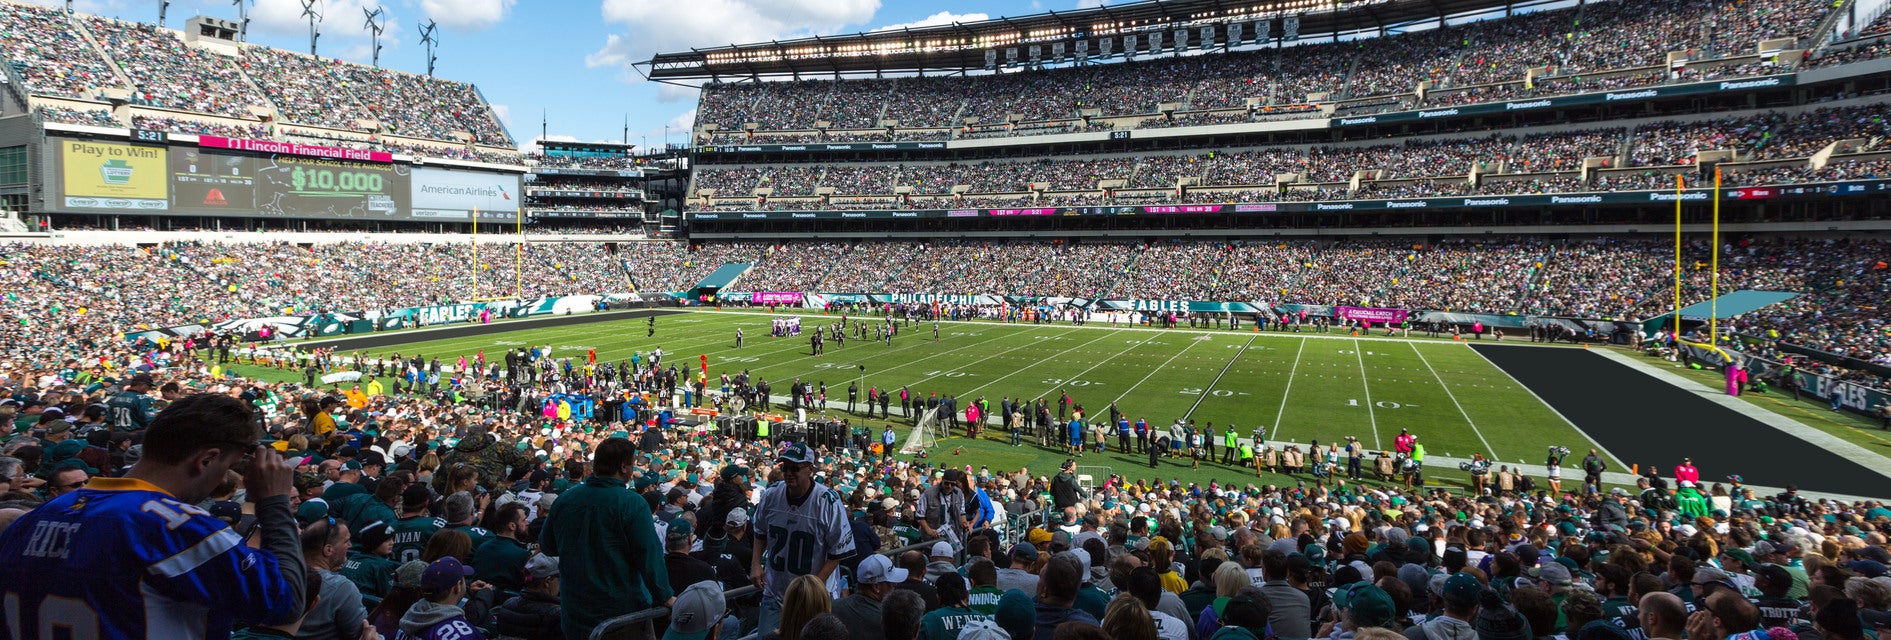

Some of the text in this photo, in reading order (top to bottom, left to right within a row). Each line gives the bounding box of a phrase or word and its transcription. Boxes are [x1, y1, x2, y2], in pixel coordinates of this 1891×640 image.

[1720, 77, 1779, 90] Panasonic
[1606, 90, 1658, 100] Panasonic
[1506, 100, 1551, 110] Panasonic
[1419, 109, 1459, 118] Panasonic
[1341, 117, 1376, 125] Panasonic
[138, 130, 162, 140] 5:21
[72, 144, 158, 158] Play to Win!
[245, 140, 371, 160] Lincoln Financial Field
[291, 166, 383, 191] $10,000
[420, 184, 497, 197] American Airlines
[1650, 192, 1708, 200] Panasonic
[1464, 198, 1509, 206] Panasonic
[1552, 195, 1602, 204] Panasonic
[892, 293, 981, 306] PHILADELPHIA
[1127, 300, 1190, 312] EAGLES
[1816, 376, 1866, 410] ELES
[1346, 399, 1401, 410] 10
[114, 407, 132, 426] 20
[22, 520, 82, 560] RICE
[394, 532, 421, 544] NYAN
[768, 525, 814, 576] 20
[942, 614, 990, 630] WENT
[437, 620, 473, 640] 28
